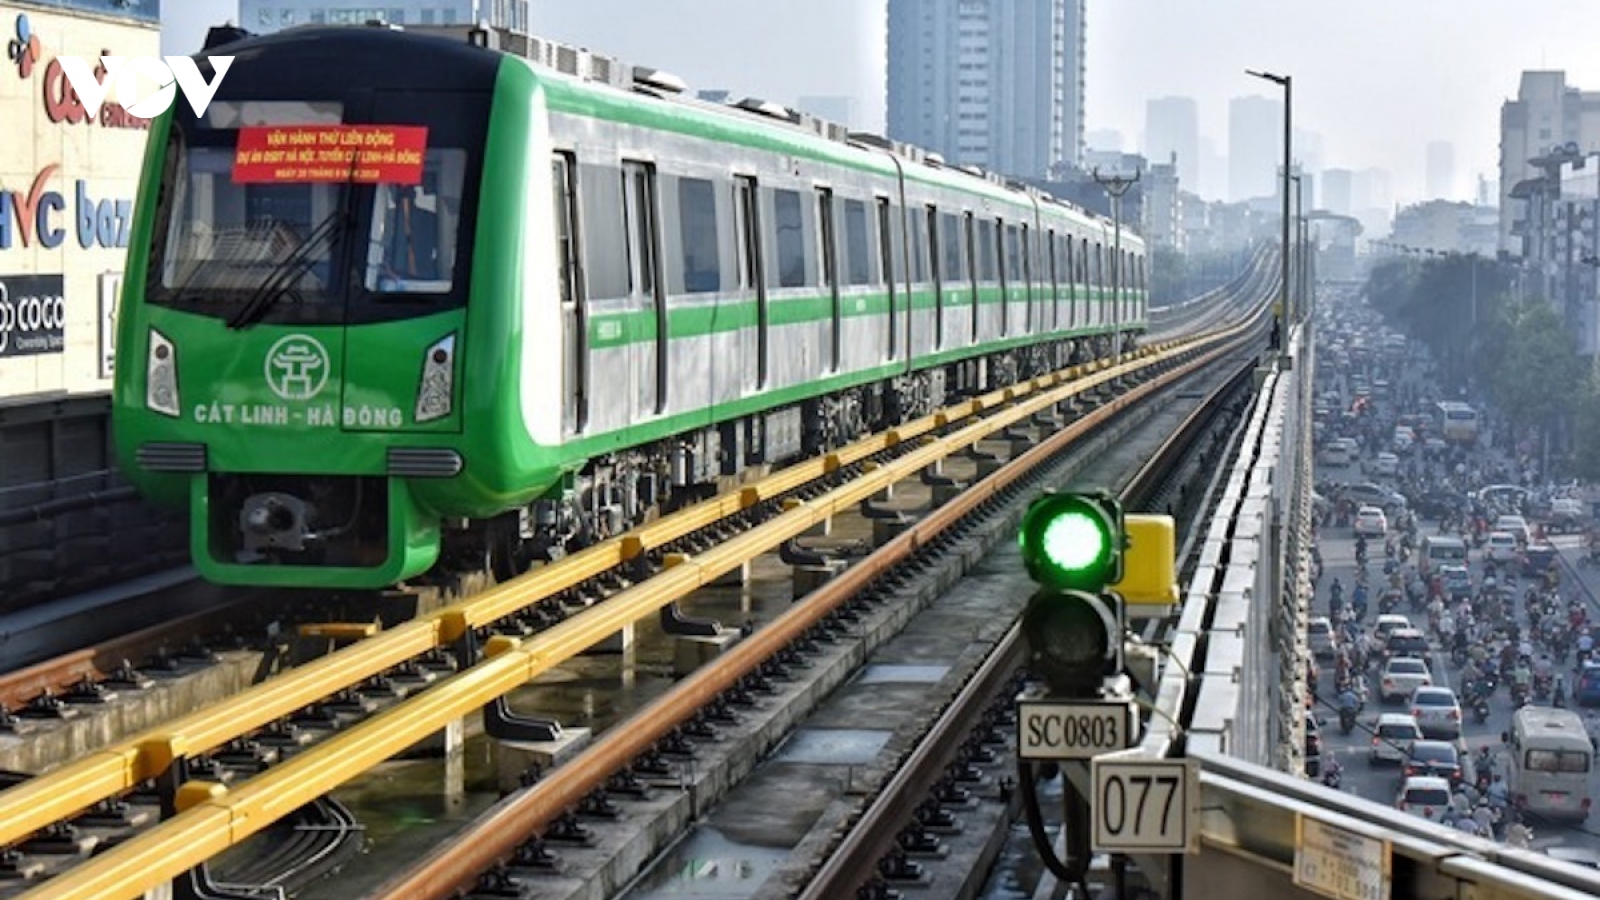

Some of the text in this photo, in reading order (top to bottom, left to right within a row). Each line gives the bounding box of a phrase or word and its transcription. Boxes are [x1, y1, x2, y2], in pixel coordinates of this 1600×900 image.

[194, 400, 234, 423] CÁT
[240, 404, 288, 425] LINH
[307, 403, 335, 426] HÀ
[1027, 714, 1118, 748] SC0803
[1103, 775, 1179, 836] 077
